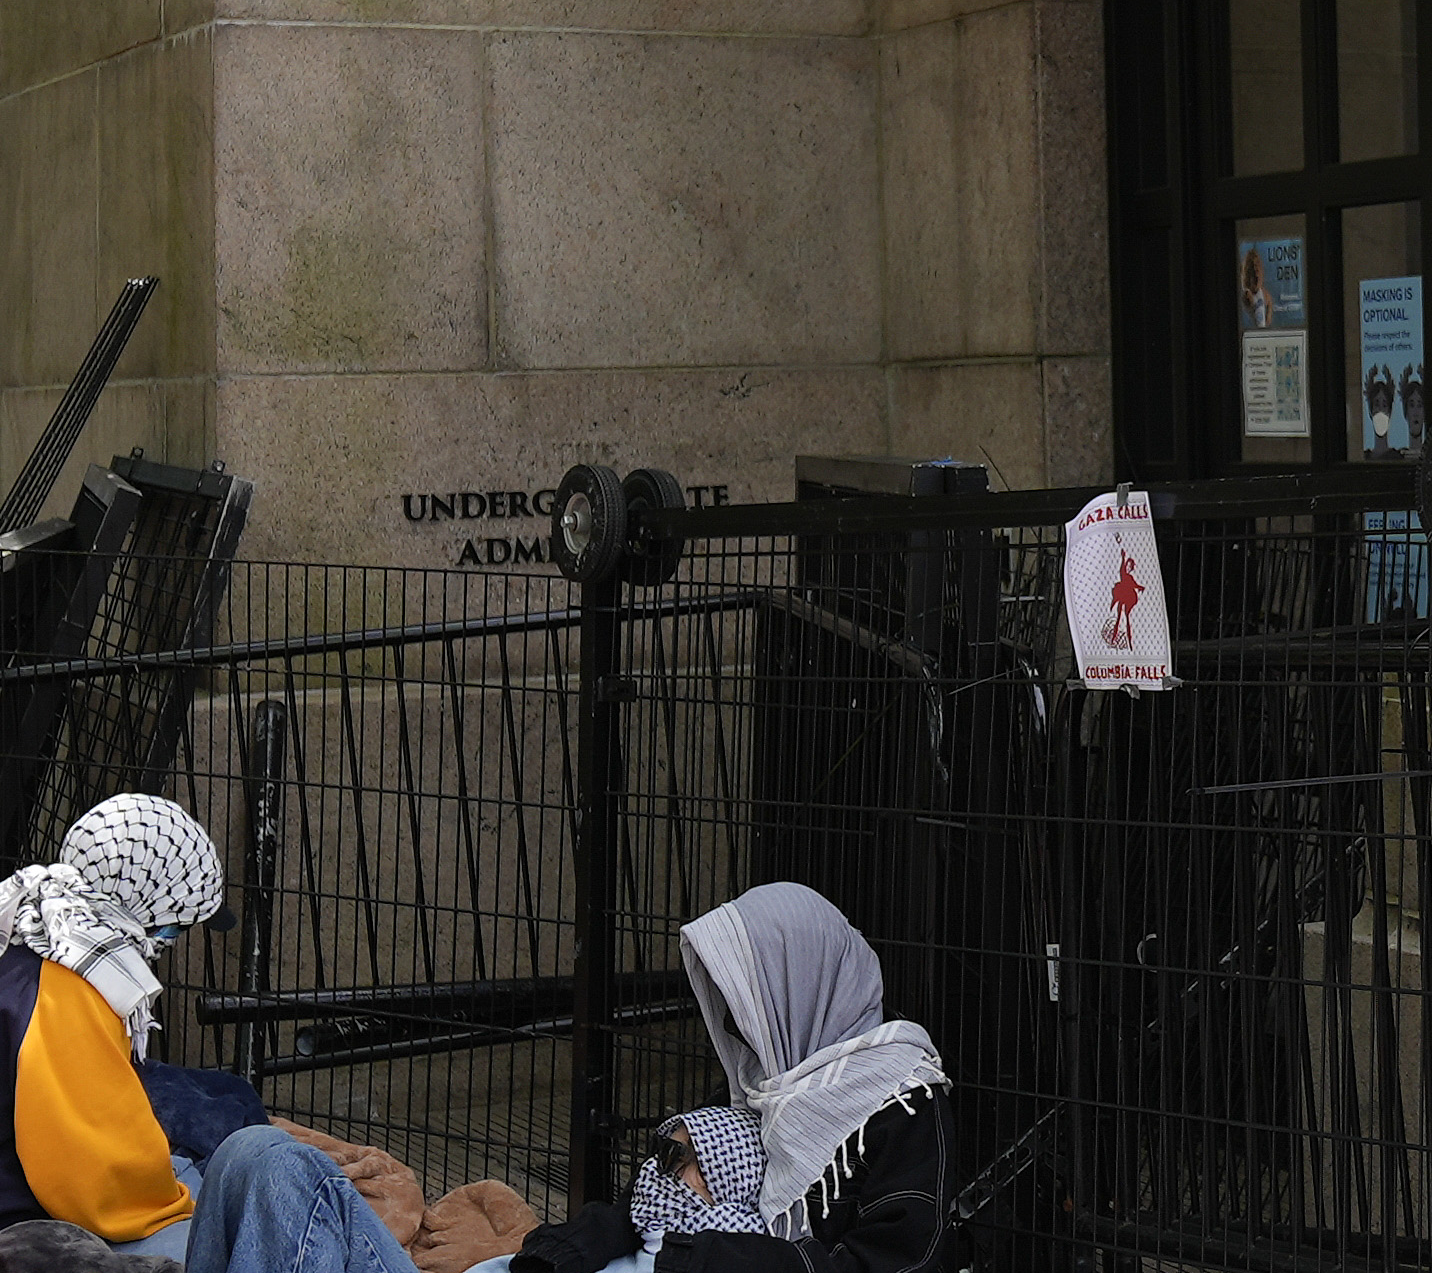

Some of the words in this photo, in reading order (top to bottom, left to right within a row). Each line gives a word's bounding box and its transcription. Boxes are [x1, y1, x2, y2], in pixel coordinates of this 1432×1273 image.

[1277, 265, 1298, 280] DEN
[1363, 288, 1402, 302] MASKING
[1405, 288, 1412, 300] IS
[1364, 308, 1409, 322] OPTIONAL
[1079, 506, 1114, 531] GAZA
[1118, 504, 1149, 519] CALLS
[1135, 665, 1167, 679] FALLS
